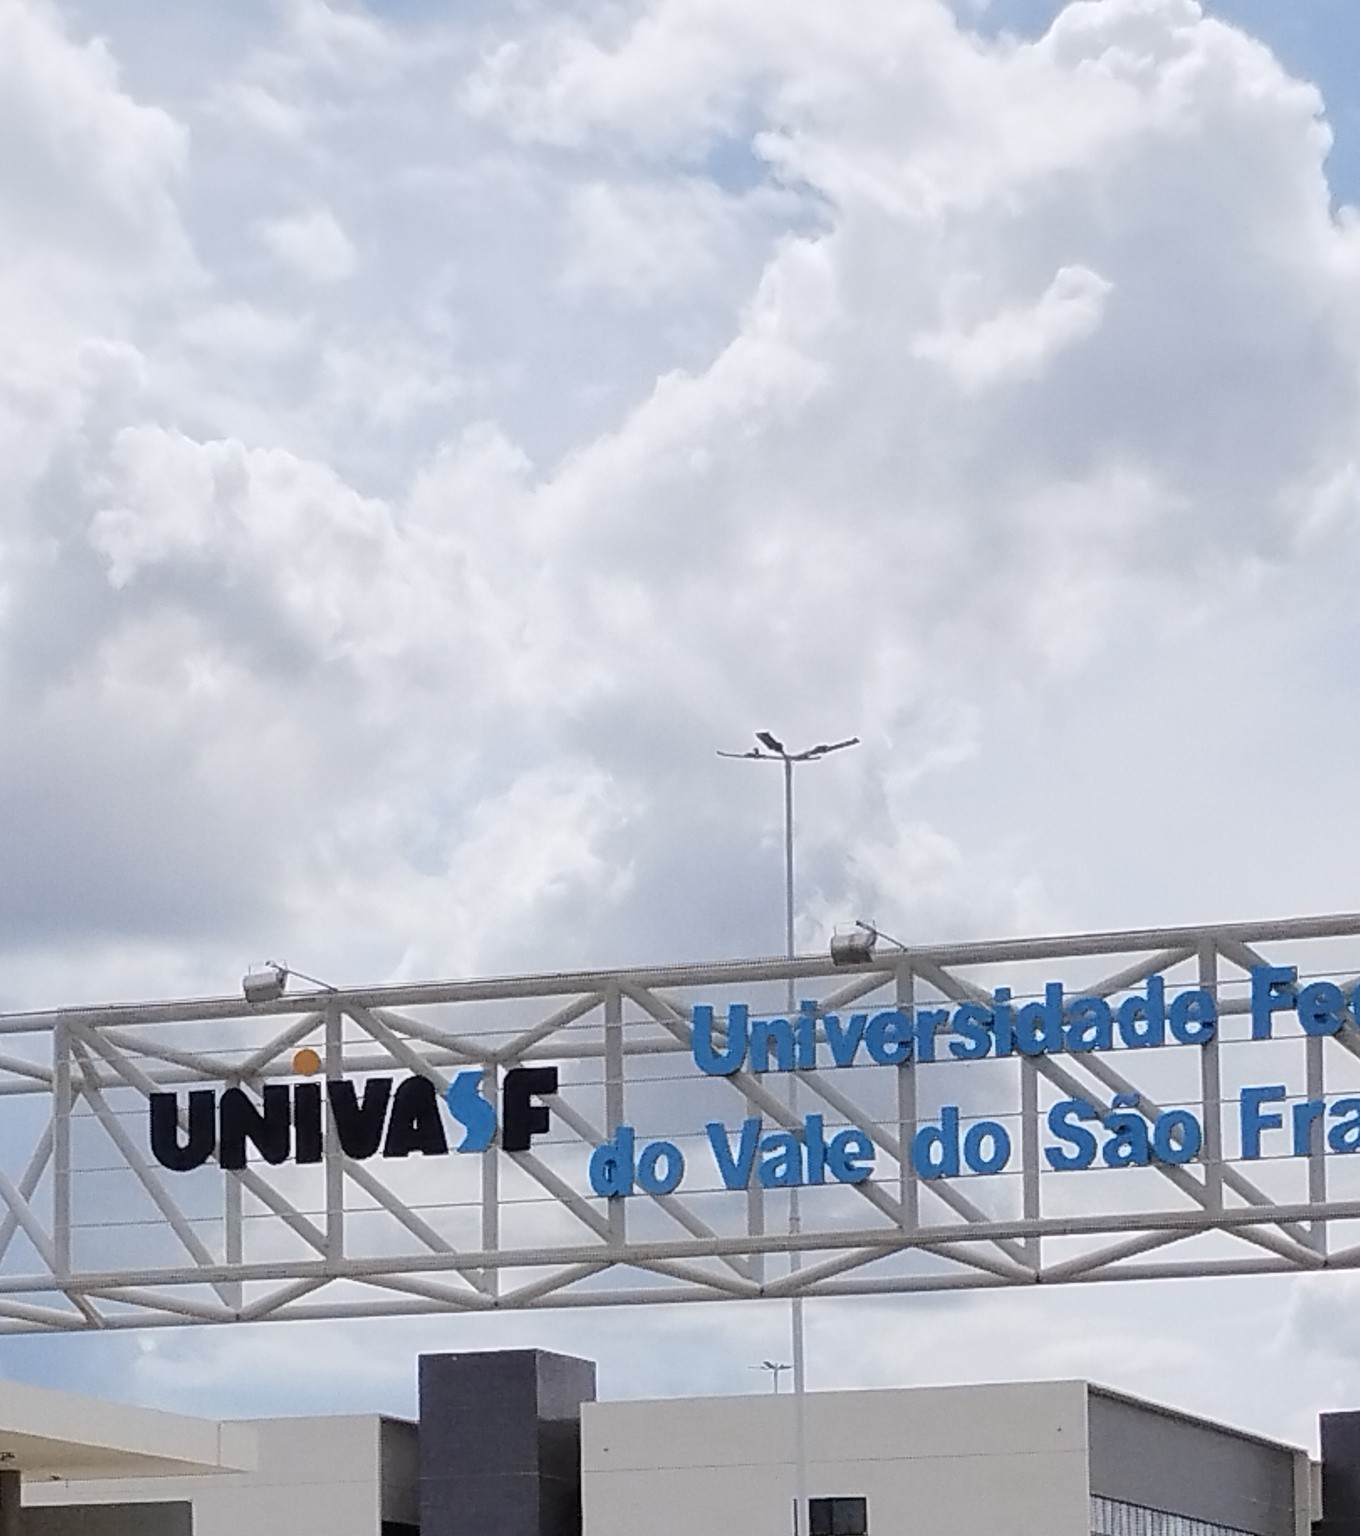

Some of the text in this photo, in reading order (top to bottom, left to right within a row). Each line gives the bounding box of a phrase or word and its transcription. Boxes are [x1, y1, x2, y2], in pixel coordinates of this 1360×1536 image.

[690, 974, 1218, 1076] Universidade
[588, 1125, 685, 1197] do
[705, 1113, 876, 1190] Vale
[910, 1105, 1011, 1179] do
[1043, 1092, 1203, 1171] São
